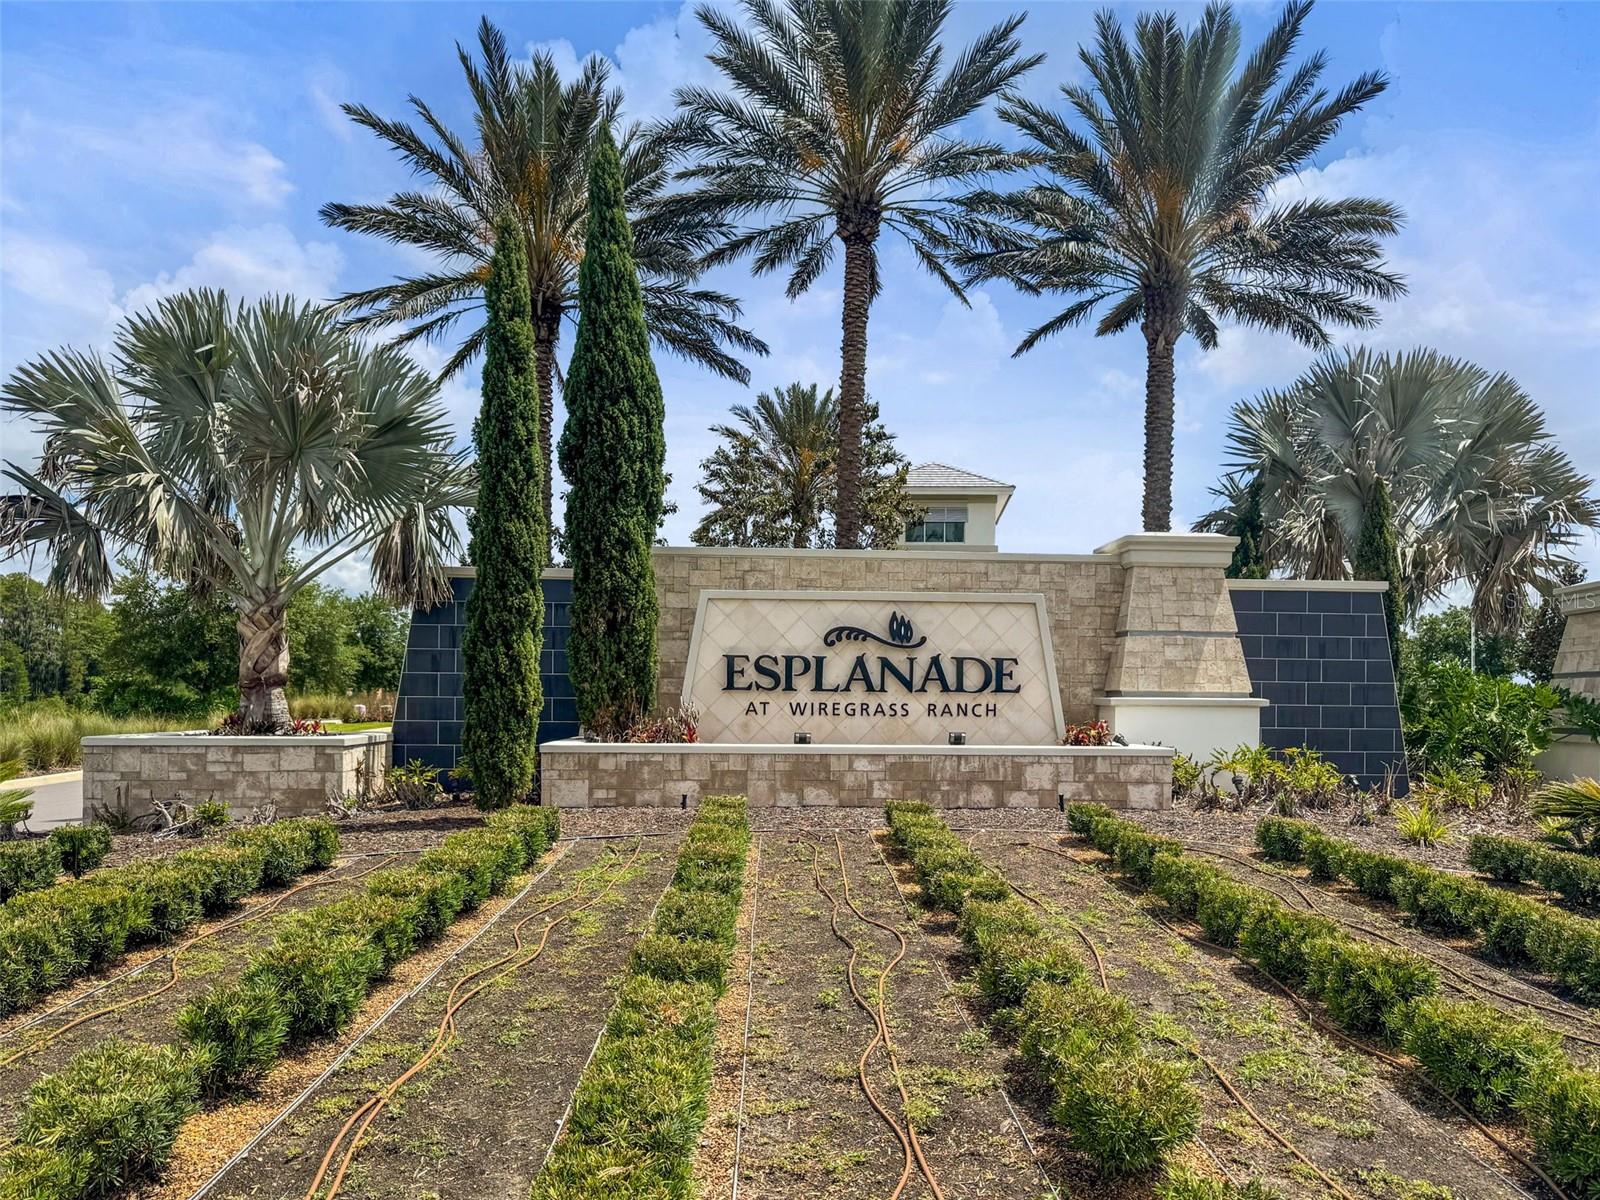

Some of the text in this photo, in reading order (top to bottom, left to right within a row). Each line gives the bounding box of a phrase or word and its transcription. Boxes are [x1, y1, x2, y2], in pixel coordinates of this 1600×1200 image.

[721, 653, 1021, 695] ESPLANADE
[745, 702, 997, 718] AT WIREGRASS RANCH
